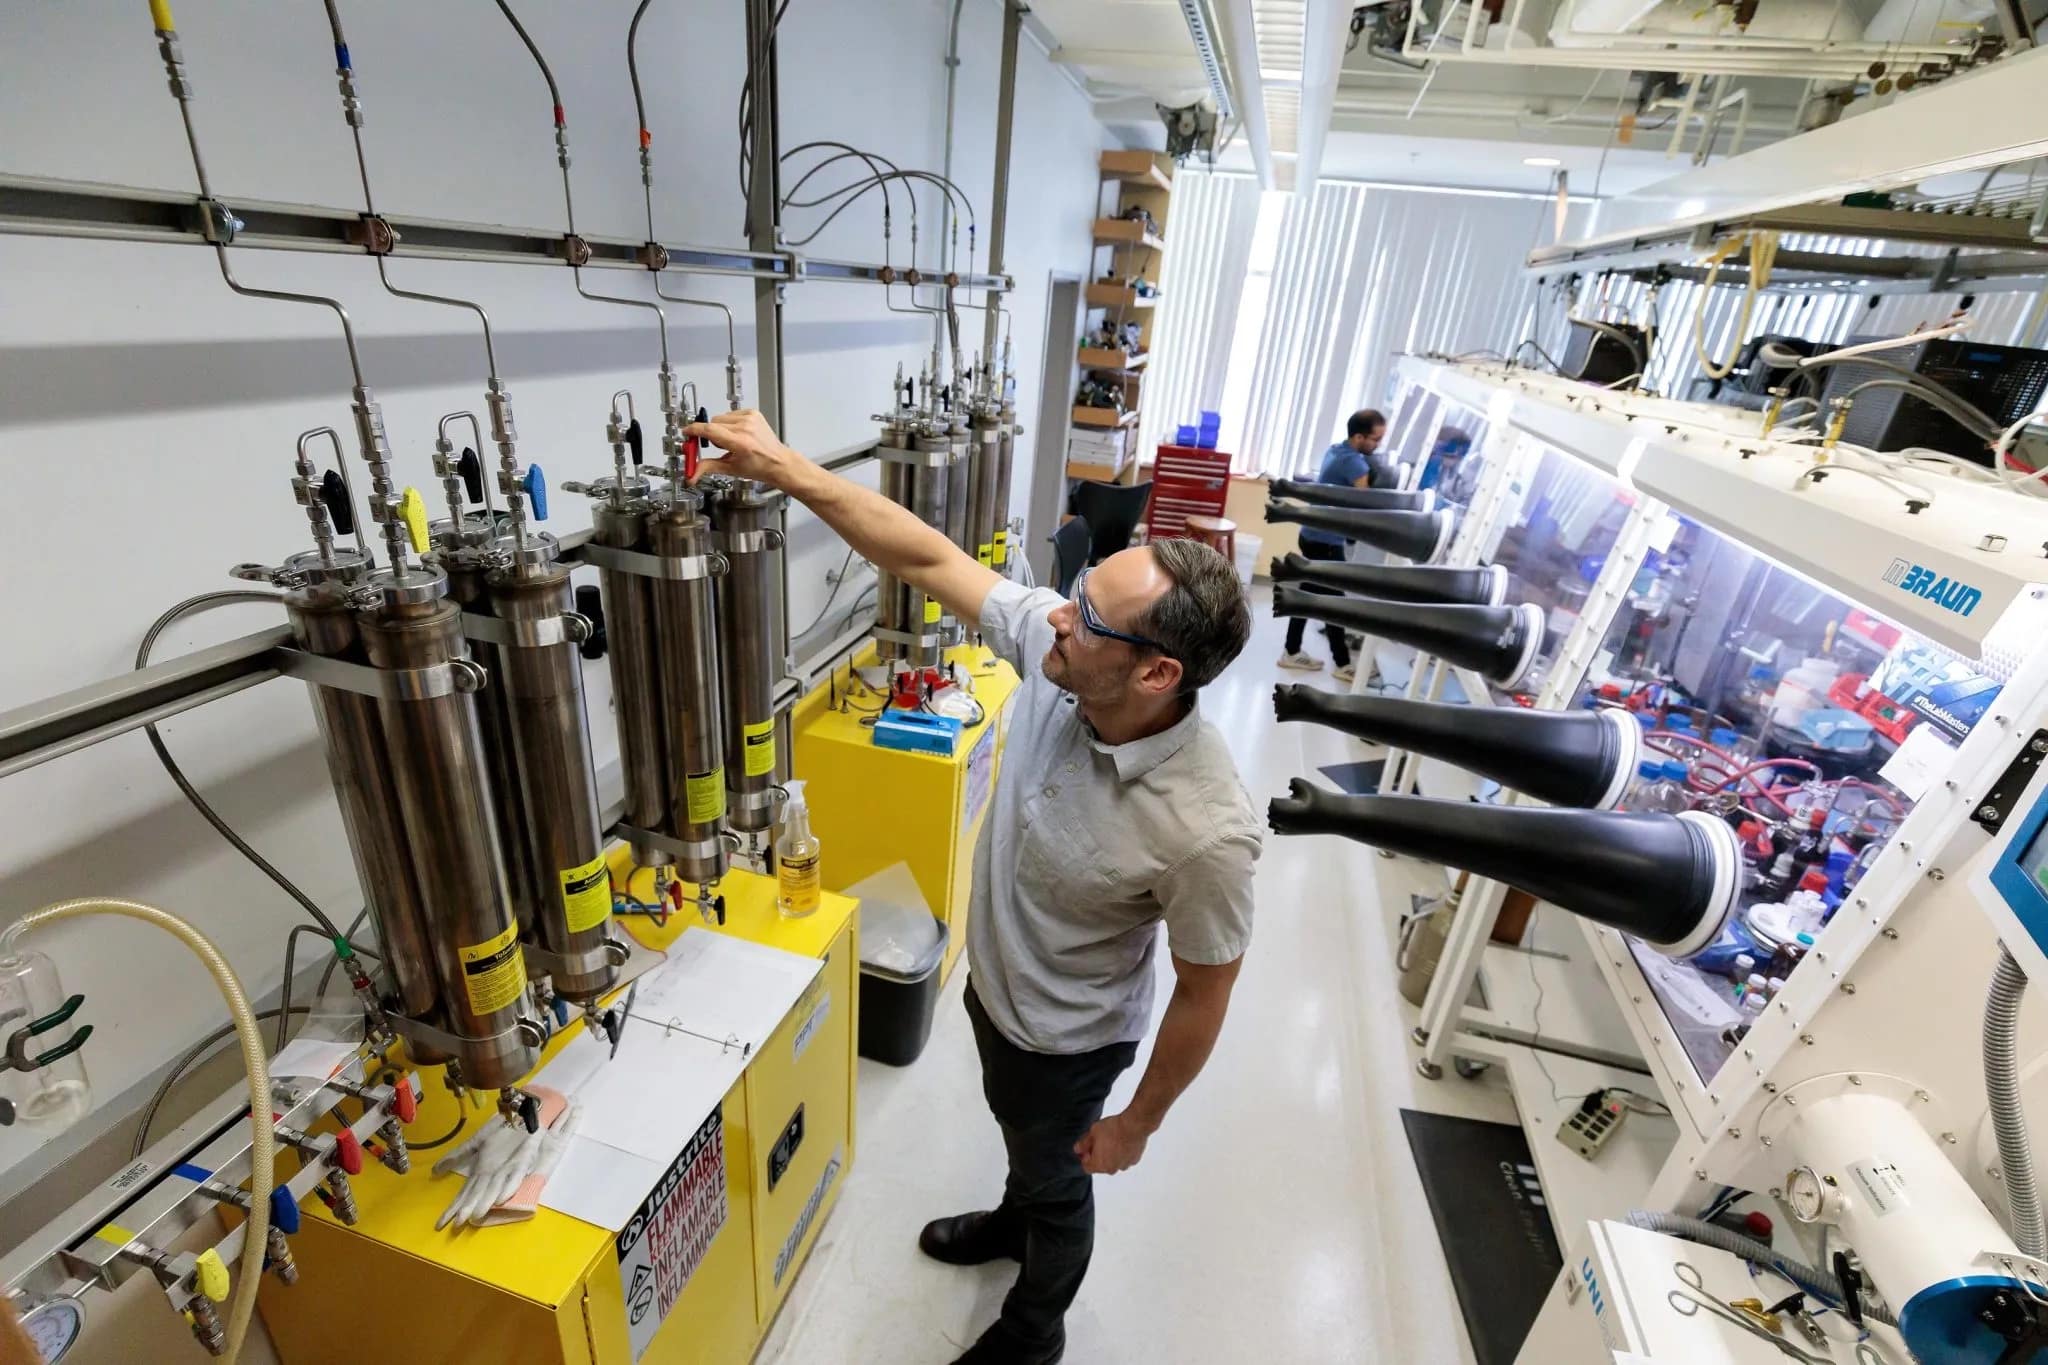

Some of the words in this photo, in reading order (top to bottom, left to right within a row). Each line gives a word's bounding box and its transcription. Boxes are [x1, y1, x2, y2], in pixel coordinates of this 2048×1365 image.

[1914, 695, 1970, 735] #TheLabMasters
[645, 1113, 718, 1221] Justrite
[646, 1127, 723, 1255] FLAMMABLE
[650, 1220, 675, 1266] KEEP
[676, 1186, 698, 1227] FIRE
[699, 1152, 722, 1195] AWAY
[654, 1166, 725, 1290] INFLAMABLE
[657, 1196, 726, 1323] INFLAMMABLE
